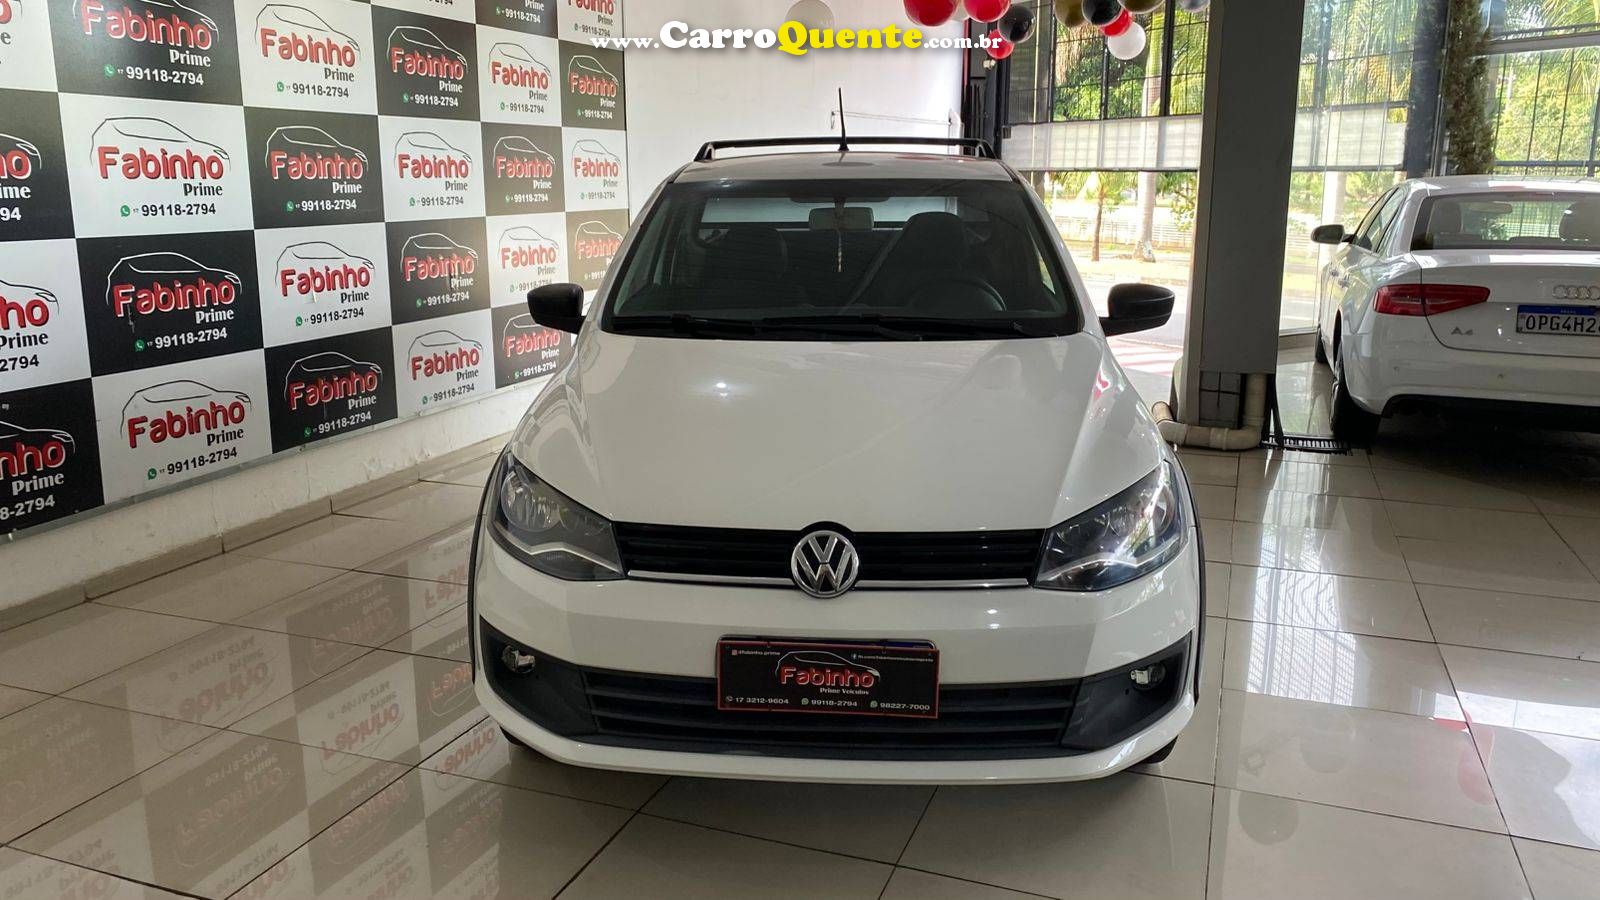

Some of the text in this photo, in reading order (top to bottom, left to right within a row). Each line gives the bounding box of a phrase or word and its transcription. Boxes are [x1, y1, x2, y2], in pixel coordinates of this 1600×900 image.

[80, 0, 212, 50] Fabinho
[260, 28, 356, 67] Fabinho
[169, 50, 211, 67] Prime
[391, 46, 464, 80] Fabinho
[126, 66, 204, 86] 99118-2794
[324, 67, 355, 82] Prime
[491, 61, 549, 90] Fabinho
[292, 83, 349, 98] 99118-2794
[439, 80, 463, 93] Prime
[569, 73, 617, 97] Fabinho
[414, 94, 459, 107] 99118-2794
[528, 90, 548, 101] Prime
[600, 98, 616, 108] Prime
[509, 102, 545, 113] 99118-2794
[98, 146, 224, 180] Fabinho
[270, 151, 364, 180] Fabinho
[398, 154, 469, 179] Fabinho
[495, 155, 553, 178] Fabinho
[573, 157, 619, 177] Fabinho
[183, 183, 223, 197] Prime
[332, 182, 363, 194] Prime
[445, 180, 468, 191] Prime
[532, 180, 552, 189] Prime
[141, 203, 216, 217] 99118-2794
[301, 200, 357, 211] 99118-2794
[420, 196, 464, 207] 99118-2794
[501, 244, 557, 269] Fabinho
[404, 252, 475, 282] Fabinho
[280, 263, 370, 297] Fabinho
[451, 277, 474, 290] Prime
[113, 277, 236, 317] Fabinho
[340, 291, 370, 304] Prime
[427, 291, 470, 306] 99118-2794
[195, 308, 235, 324] Prime
[310, 307, 364, 325] 99118-2794
[1525, 314, 1600, 333] OPG4H2
[155, 327, 228, 349] 99118-2794
[504, 329, 560, 358] Fabinho
[411, 347, 480, 381] Fabinho
[541, 349, 560, 360] Prime
[456, 369, 479, 382] Prime
[288, 370, 379, 411] Fabinho
[433, 383, 475, 402] 99118-2794
[348, 395, 377, 410] Prime
[127, 401, 245, 448] Fabinho
[318, 411, 372, 434] 99118-2794
[206, 427, 244, 446] Prime
[167, 447, 238, 475] 99118-2794
[12, 473, 65, 496] Prime
[780, 666, 875, 688] Fabinho
